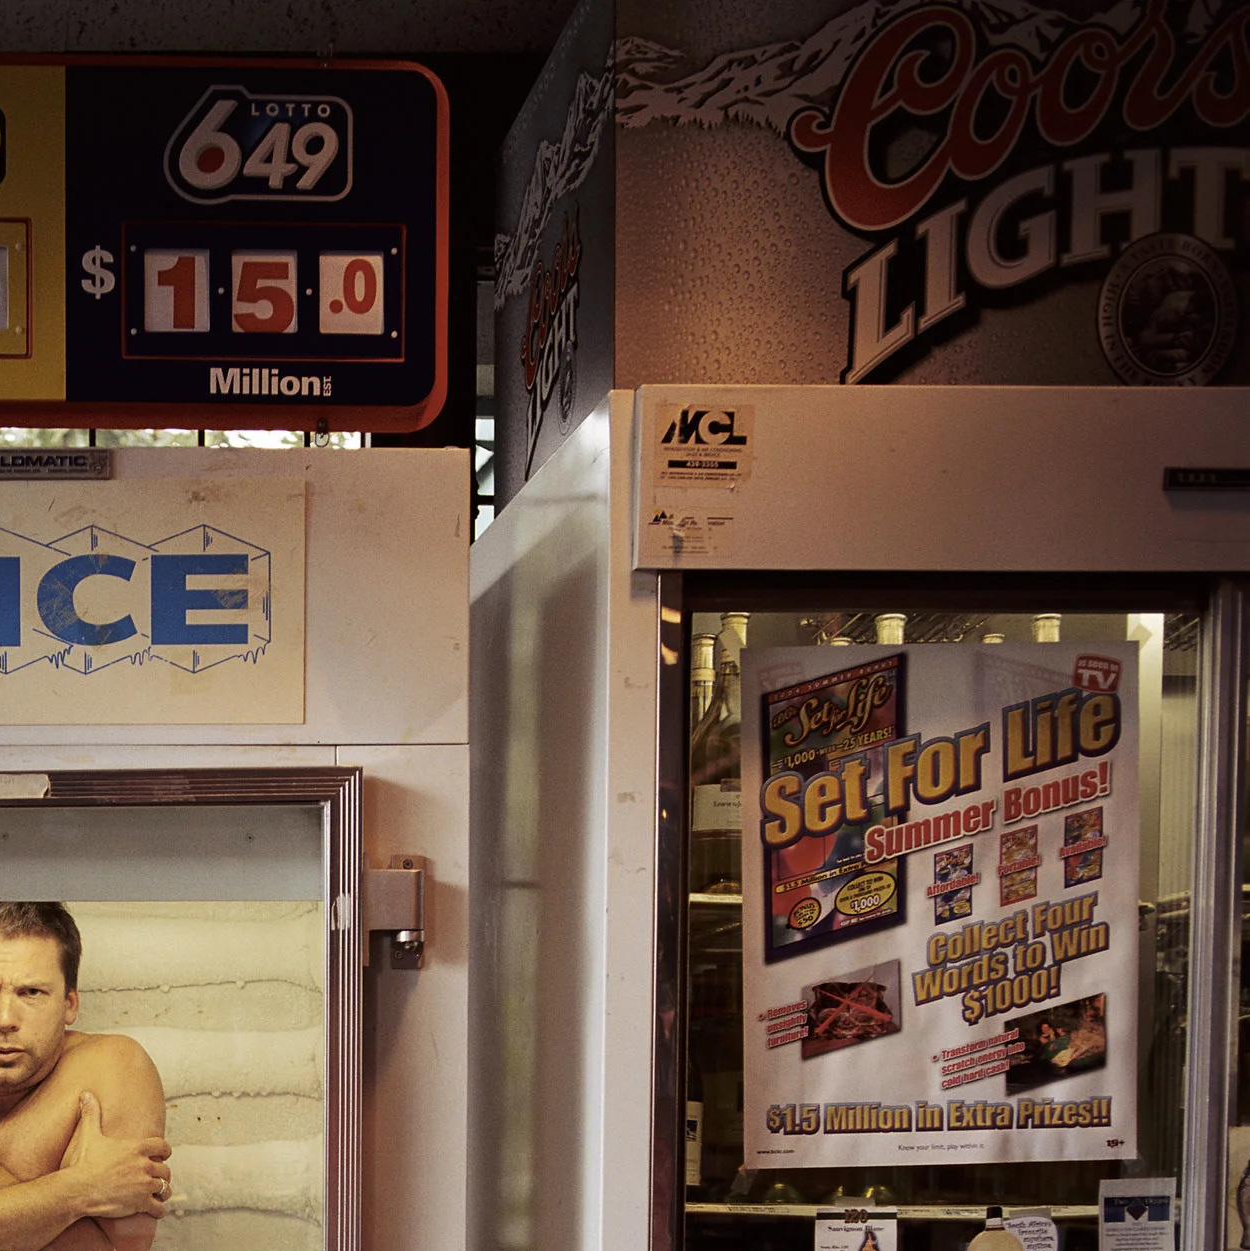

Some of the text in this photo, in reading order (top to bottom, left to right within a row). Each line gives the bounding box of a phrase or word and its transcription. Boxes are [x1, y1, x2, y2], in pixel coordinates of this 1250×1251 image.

[251, 102, 331, 118] LOTTO
[790, 4, 1250, 232] Coors
[81, 245, 116, 300] $
[844, 146, 1250, 384] LIGHT
[209, 367, 320, 395] Million
[1077, 669, 1117, 689] TV
[783, 697, 835, 747] Set
[762, 690, 1119, 848] Set For Life
[865, 761, 1110, 862] Summer Bonus!
[1060, 836, 1107, 860] Available!
[801, 873, 827, 886] Million
[998, 855, 1040, 877] Portable!
[927, 872, 979, 897] Affordable!
[928, 891, 1098, 966] Collect Four
[913, 922, 1109, 1005] Words to Win
[962, 966, 1060, 1025] $1000!
[767, 1000, 807, 1019] Removes
[767, 1013, 808, 1034] unsightly
[768, 1026, 810, 1048] furniture!
[942, 1028, 1019, 1059] Transform natural
[942, 1056, 976, 1074] scratch
[978, 1048, 1007, 1065] energy
[942, 1060, 1010, 1089] cold hard cash!
[768, 1096, 1111, 1134] $1.5 Million in Extra Prizes!!
[947, 1144, 959, 1152] play
[960, 1143, 978, 1151] within
[828, 1225, 863, 1233] Sauvignon
[845, 1209, 868, 1224] 120
